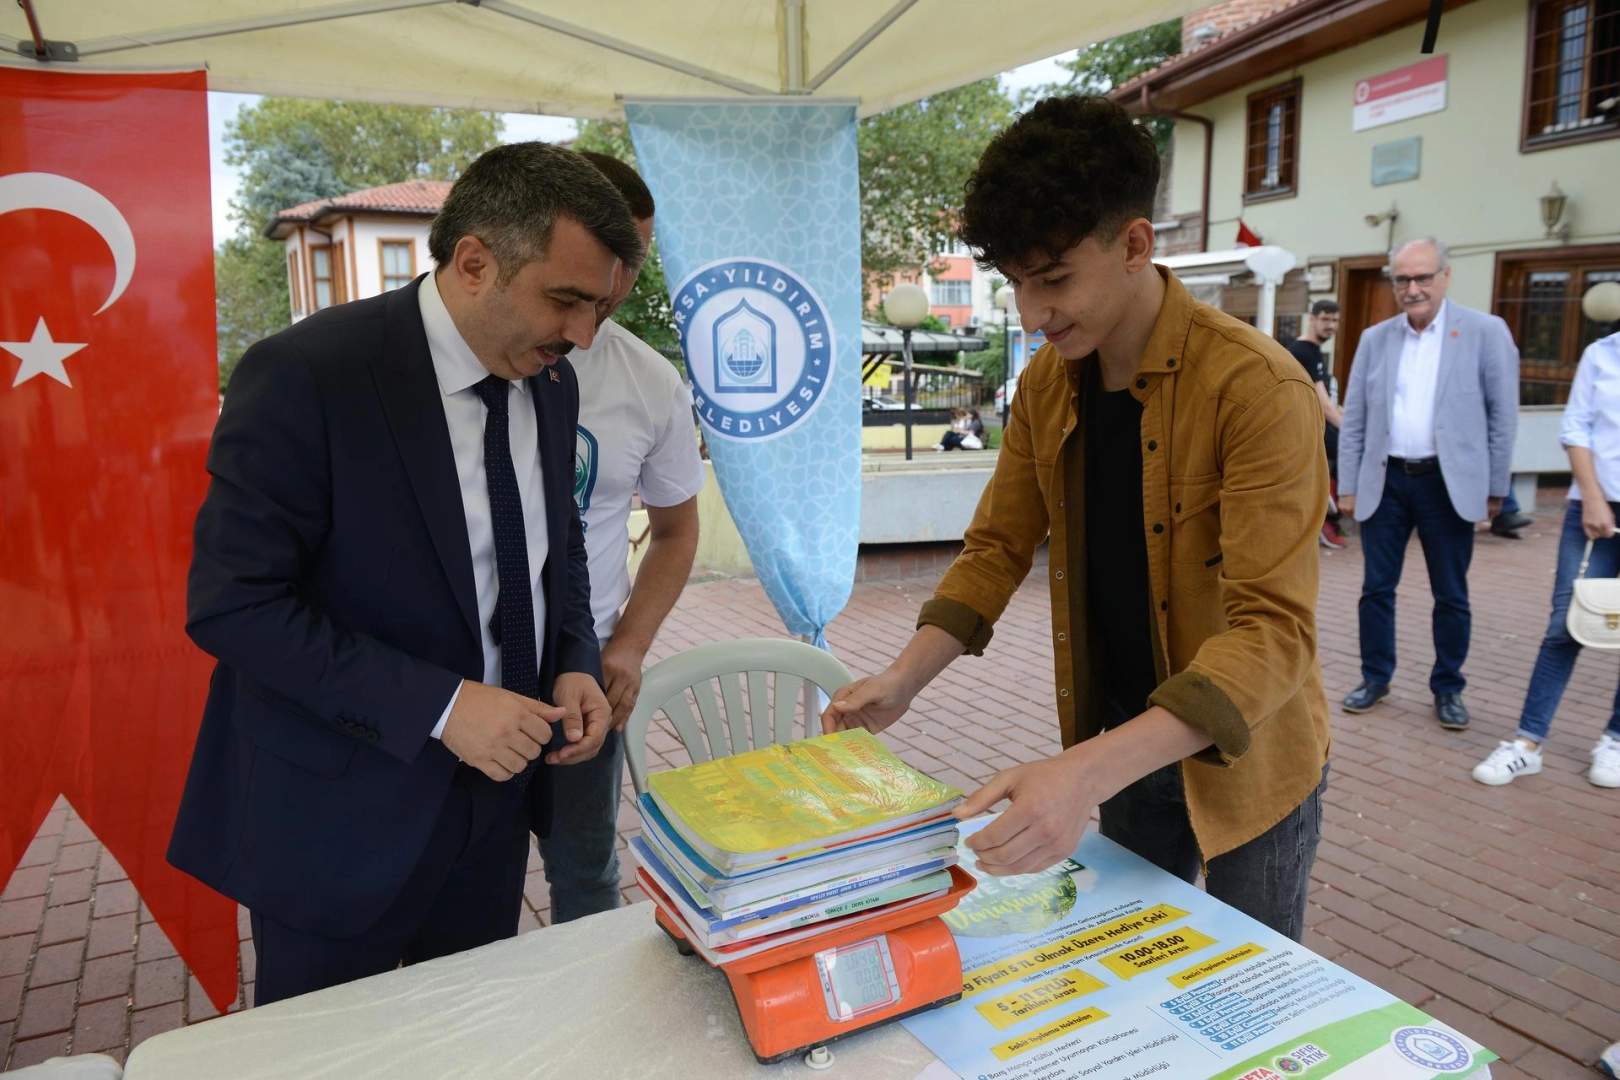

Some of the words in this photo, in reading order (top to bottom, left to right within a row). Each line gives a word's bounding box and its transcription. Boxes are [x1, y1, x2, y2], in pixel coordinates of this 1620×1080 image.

[724, 269, 824, 349] YILDIRIM
[825, 906, 843, 915] TÜRKÇE
[972, 968, 1009, 986] Fiyatı
[1008, 964, 1018, 972] 5
[1016, 960, 1035, 969] TL
[1034, 945, 1075, 962] Olmak
[1071, 934, 1106, 948] Üzere
[1104, 920, 1144, 938] Hediye
[1143, 910, 1168, 924] Çeki
[1119, 935, 1185, 962] 10.00-18.00
[1134, 952, 1168, 968] Saatleri
[1170, 945, 1190, 956] Arası
[1070, 957, 1084, 966] Tüm
[1200, 960, 1226, 974] Toplama
[996, 1002, 1009, 1012] 5
[1018, 992, 1034, 1003] 11
[1032, 976, 1076, 997] EYLÜL
[1011, 997, 1052, 1017] Tarihleri
[1054, 987, 1078, 1000] Arası
[1227, 1012, 1249, 1023] Cuma
[1252, 1024, 1273, 1035] Pazar
[1008, 1040, 1029, 1052] Sabit
[1028, 1027, 1060, 1042] Toplama
[1058, 1044, 1098, 1062] Uyumayan
[1096, 1026, 1139, 1046] Kütüphanesi
[1291, 1044, 1318, 1060] SIFIR
[1007, 1060, 1032, 1073] Manço
[1032, 1050, 1054, 1062] Kültür
[1054, 1038, 1082, 1053] Merkezi
[1078, 1062, 1102, 1077] Sosyal
[1143, 1033, 1179, 1051] Müdürlüğü
[1301, 1050, 1328, 1066] ATIK
